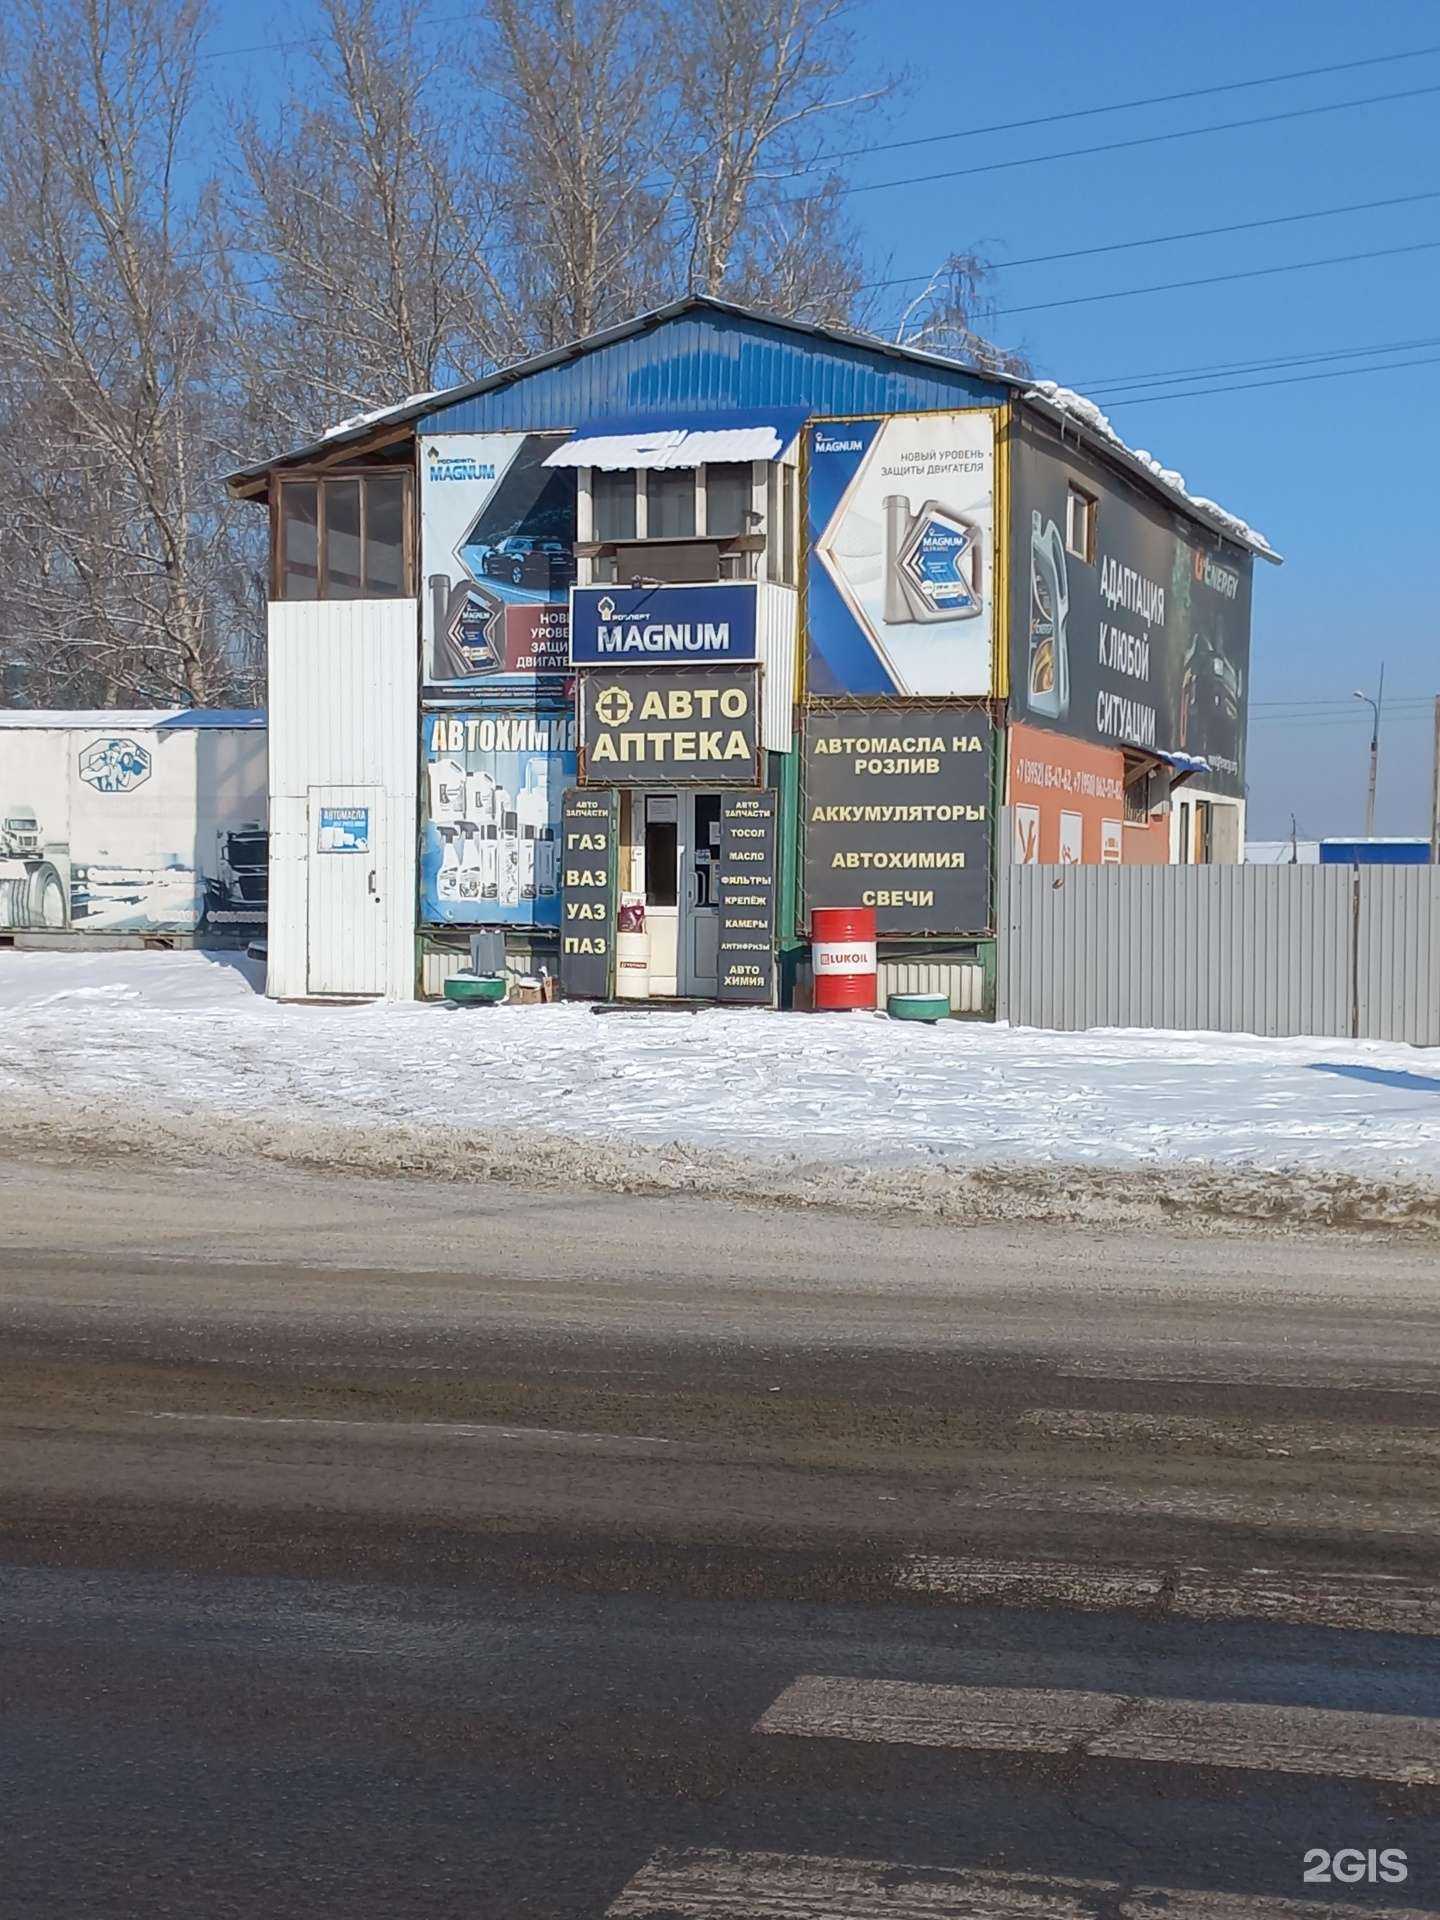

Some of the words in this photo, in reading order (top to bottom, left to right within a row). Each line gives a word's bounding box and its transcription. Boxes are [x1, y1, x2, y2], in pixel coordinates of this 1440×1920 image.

[815, 440, 863, 453] MAGNUM
[900, 451, 937, 462] НОВЫЙ
[939, 450, 984, 461] УРОВЕНЬ
[430, 464, 496, 482] MAGNUM
[881, 465, 925, 477] ЗАЩИТЫ
[926, 463, 984, 475] ДВИГАТЕЛЯ
[923, 537, 964, 546] MAGNUM
[1100, 555, 1165, 628] АДАПТАЦИЯ
[540, 612, 569, 624] НОВ
[597, 622, 729, 652] MAGNUM
[1099, 621, 1108, 666] К
[1109, 626, 1149, 682] ЛЮБОЙ
[639, 688, 748, 720] АВТО
[1097, 690, 1156, 747] СИТУАЦИИ
[591, 730, 751, 762] АПТЕКА
[814, 737, 946, 754] АВТОМАСЛА
[952, 736, 983, 752] НА
[855, 758, 940, 775] РОЗЛИВ
[566, 809, 608, 817] ЗАПЧАСТИ
[812, 805, 986, 822] АККУМУЛЯТОРЫ
[731, 829, 765, 838] ТОСОЛ
[567, 834, 606, 850] ГАЗ
[729, 852, 765, 860] МАСЛО
[831, 852, 965, 869] АВТОХИМИЯ
[566, 870, 607, 886] ВАЗ
[720, 877, 771, 885] ФИЛЬТРЫ
[862, 890, 934, 907] СВЕЧИ
[567, 903, 606, 919] УАЗ
[725, 919, 769, 929] КАМЕРЫ
[565, 937, 606, 954] ПАЗ
[830, 954, 868, 963] LUKOIL
[729, 966, 760, 975] АВТО
[723, 976, 765, 986] ХИМИЯ
